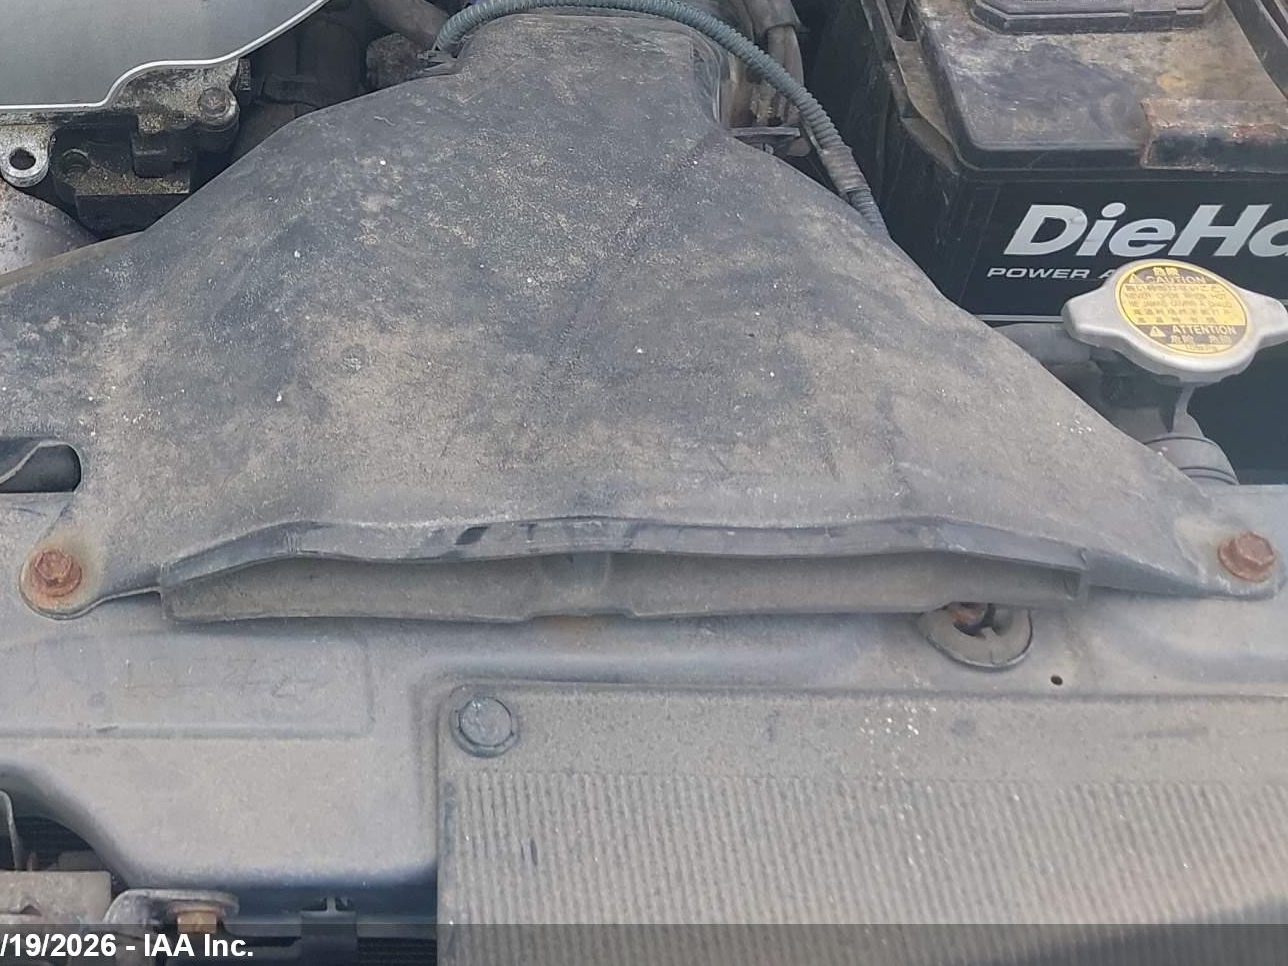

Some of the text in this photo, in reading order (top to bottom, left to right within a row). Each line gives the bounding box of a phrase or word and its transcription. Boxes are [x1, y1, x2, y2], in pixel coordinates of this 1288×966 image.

[987, 267, 1090, 279] POWER
[1145, 276, 1207, 284] CAUTION
[1172, 325, 1238, 335] ATTENTION
